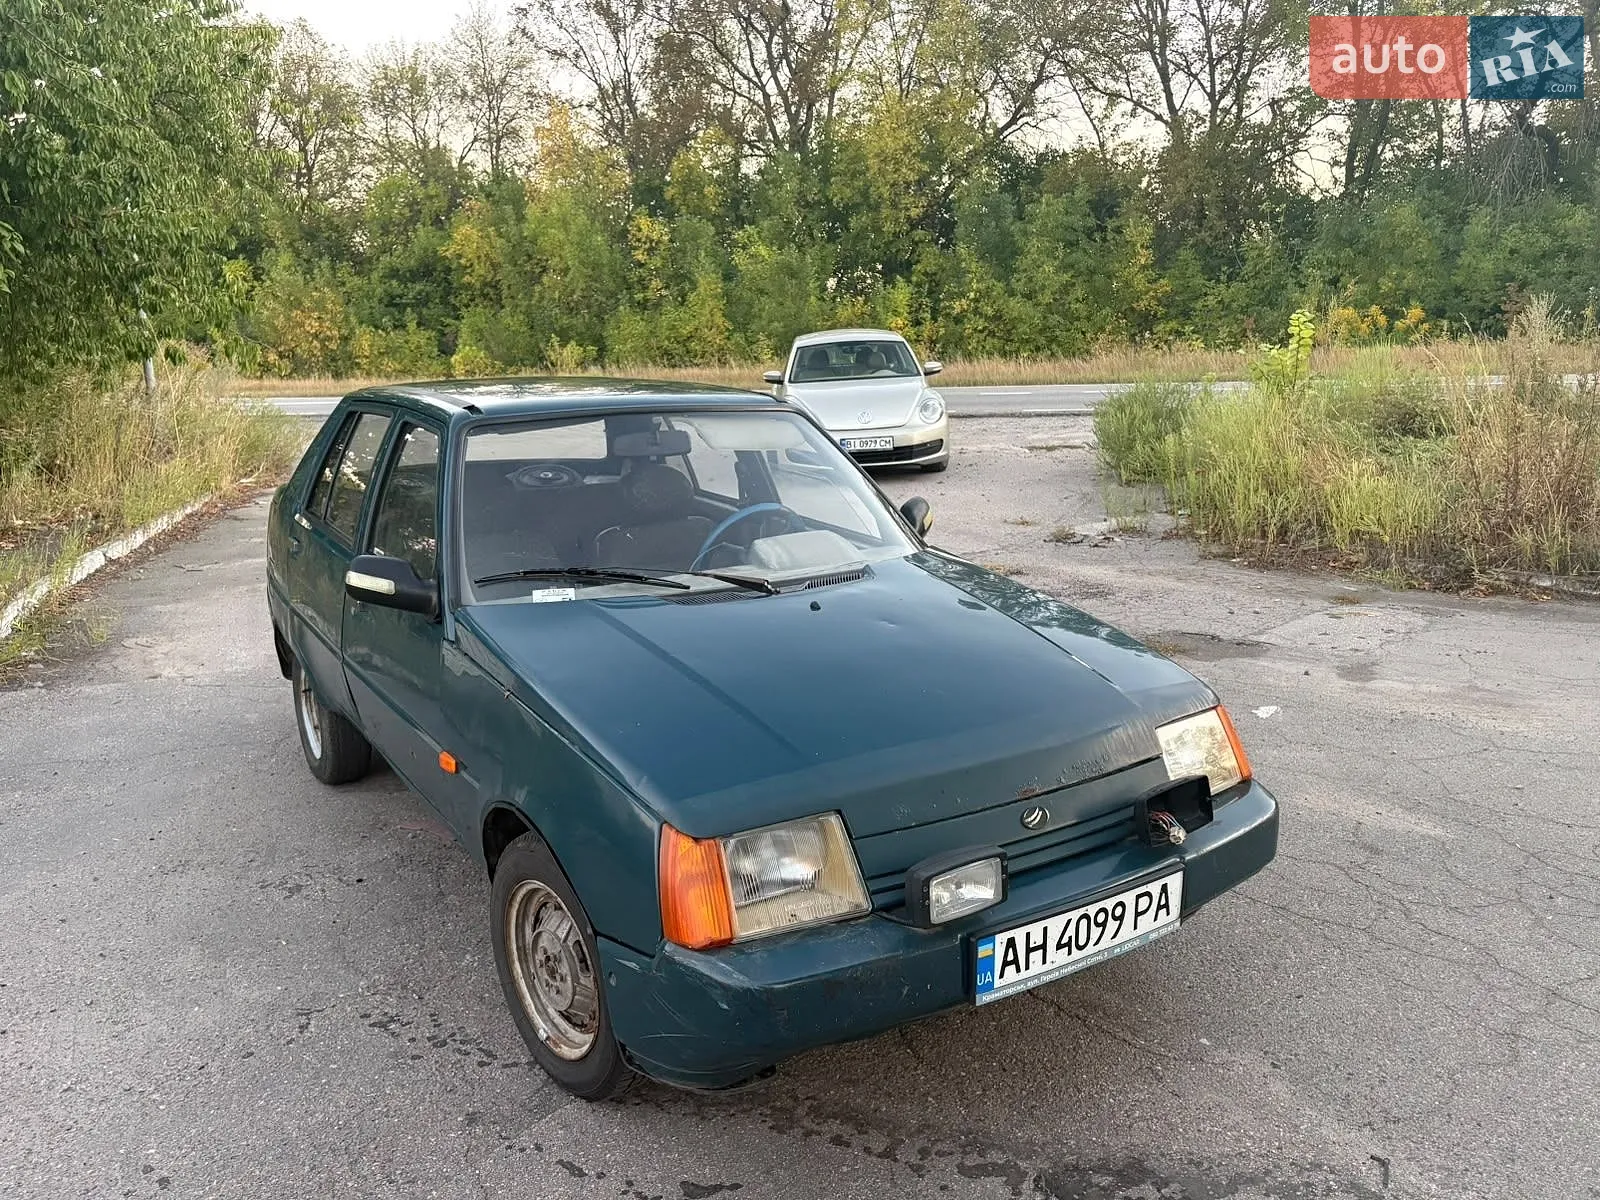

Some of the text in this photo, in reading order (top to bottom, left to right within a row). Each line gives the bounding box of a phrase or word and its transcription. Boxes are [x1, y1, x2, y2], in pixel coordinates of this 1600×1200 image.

[879, 438, 892, 448] CM
[998, 883, 1171, 980] AH 4099 PA
[977, 971, 993, 986] UA
